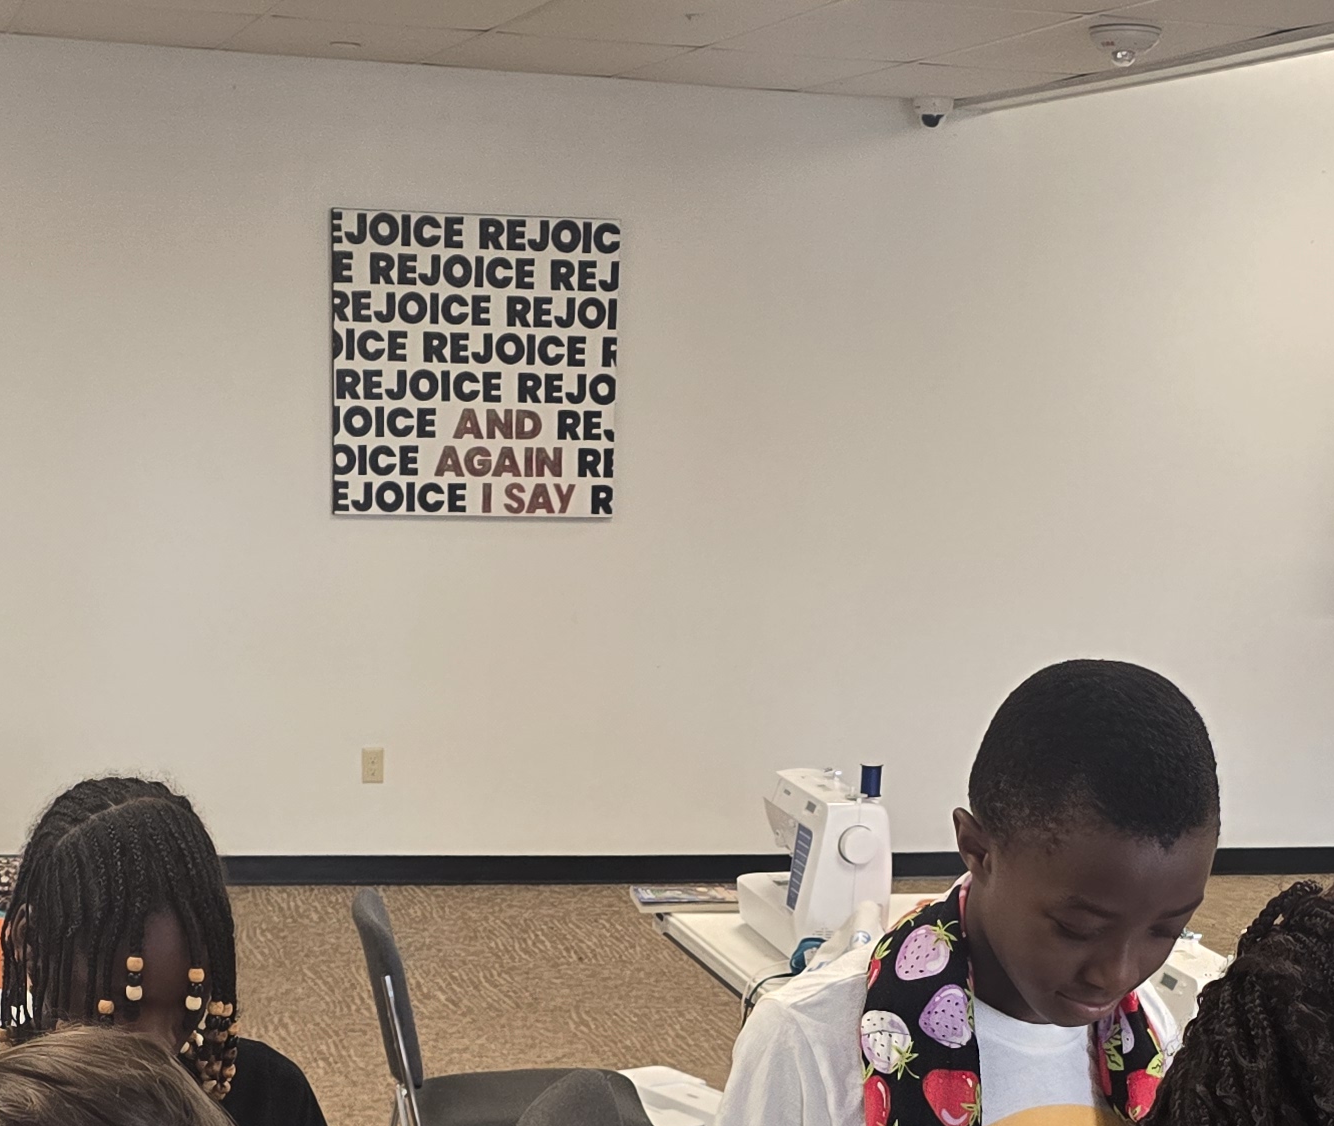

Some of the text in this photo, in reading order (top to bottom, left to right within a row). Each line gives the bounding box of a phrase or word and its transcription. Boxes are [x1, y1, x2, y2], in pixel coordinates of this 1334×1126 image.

[479, 218, 620, 253] REJOIC
[333, 251, 619, 291] E REJOICE REJ
[507, 296, 617, 330] REJOI
[423, 331, 586, 367] REJOICE
[336, 369, 616, 405] REJOICE REJO
[453, 409, 542, 440] AND
[334, 444, 419, 476] OICE
[434, 446, 562, 477] AGAIN
[334, 480, 613, 514] EJOICE I SAY R
